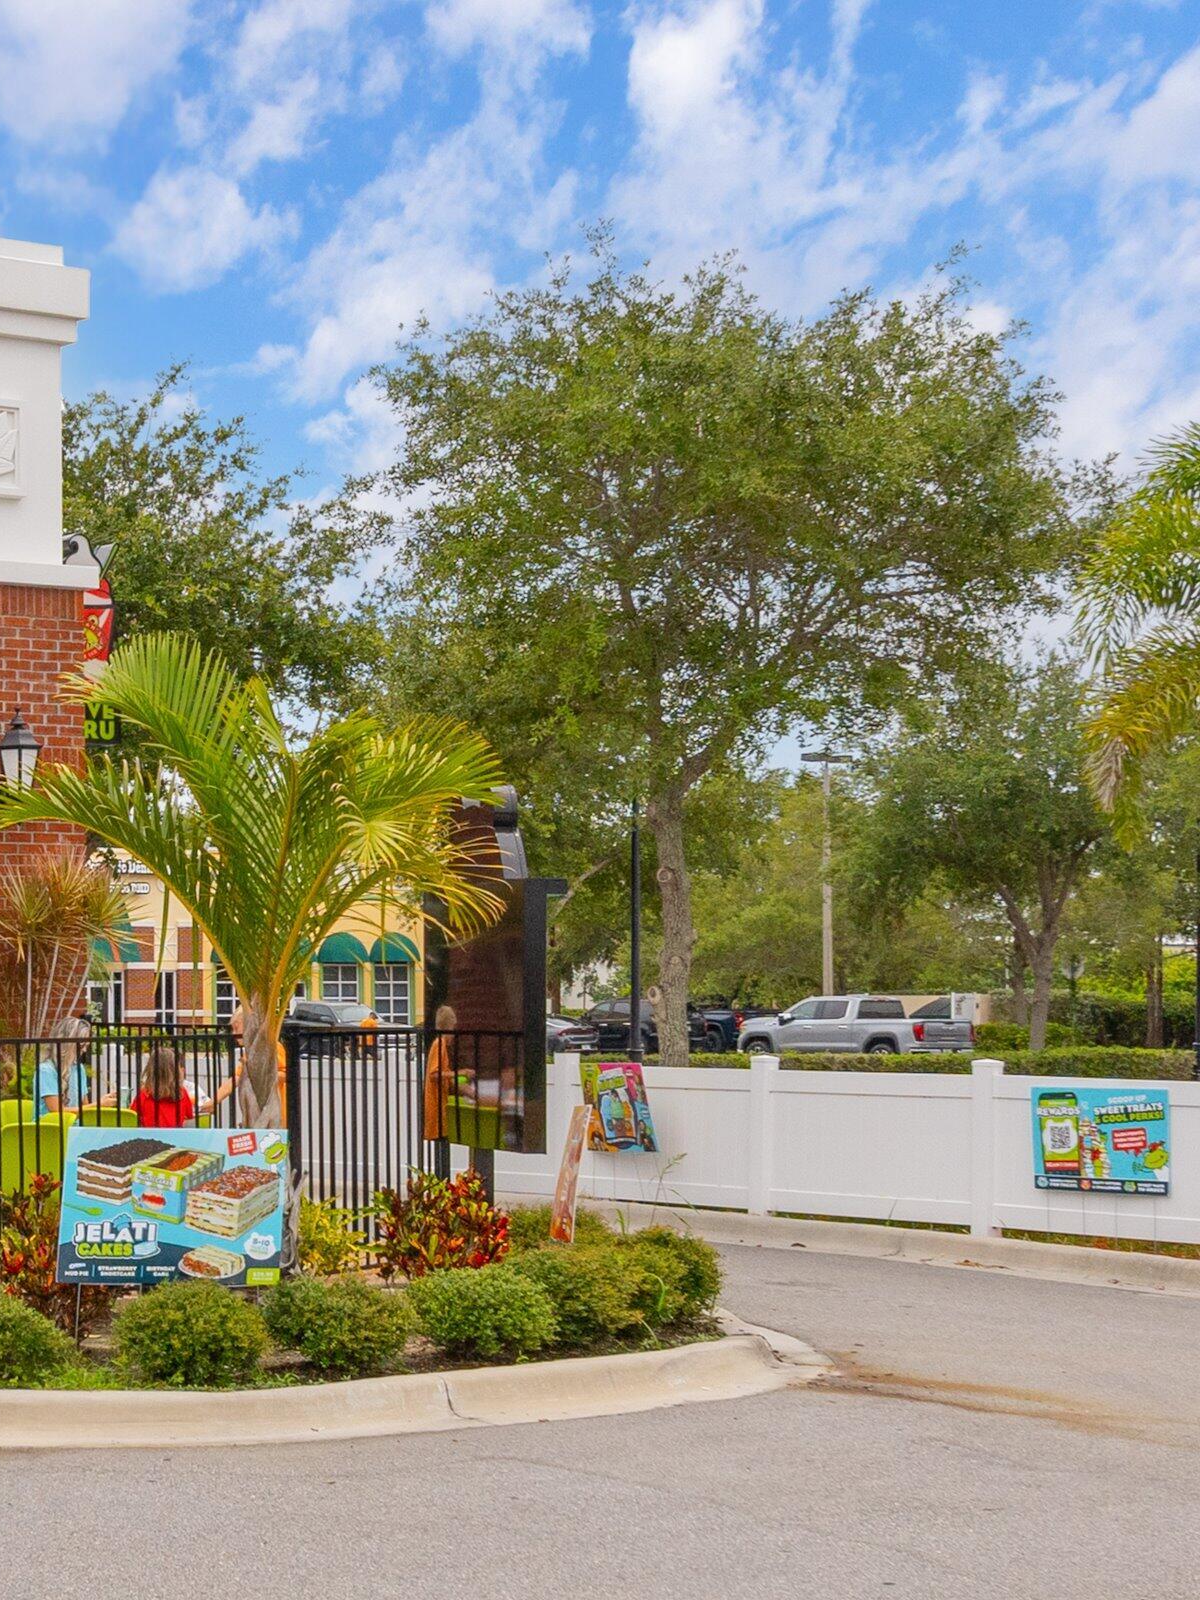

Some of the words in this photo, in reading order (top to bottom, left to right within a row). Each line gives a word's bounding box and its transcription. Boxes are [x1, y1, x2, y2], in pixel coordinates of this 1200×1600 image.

[1036, 1106, 1080, 1117] REWARDS
[1094, 1105, 1125, 1115] SWEET
[1127, 1102, 1163, 1113] TREATS
[1102, 1114, 1127, 1123] COOL
[1129, 1111, 1164, 1121] PERKS!
[74, 1221, 157, 1242] JELATI
[78, 1242, 133, 1256] CAKES
